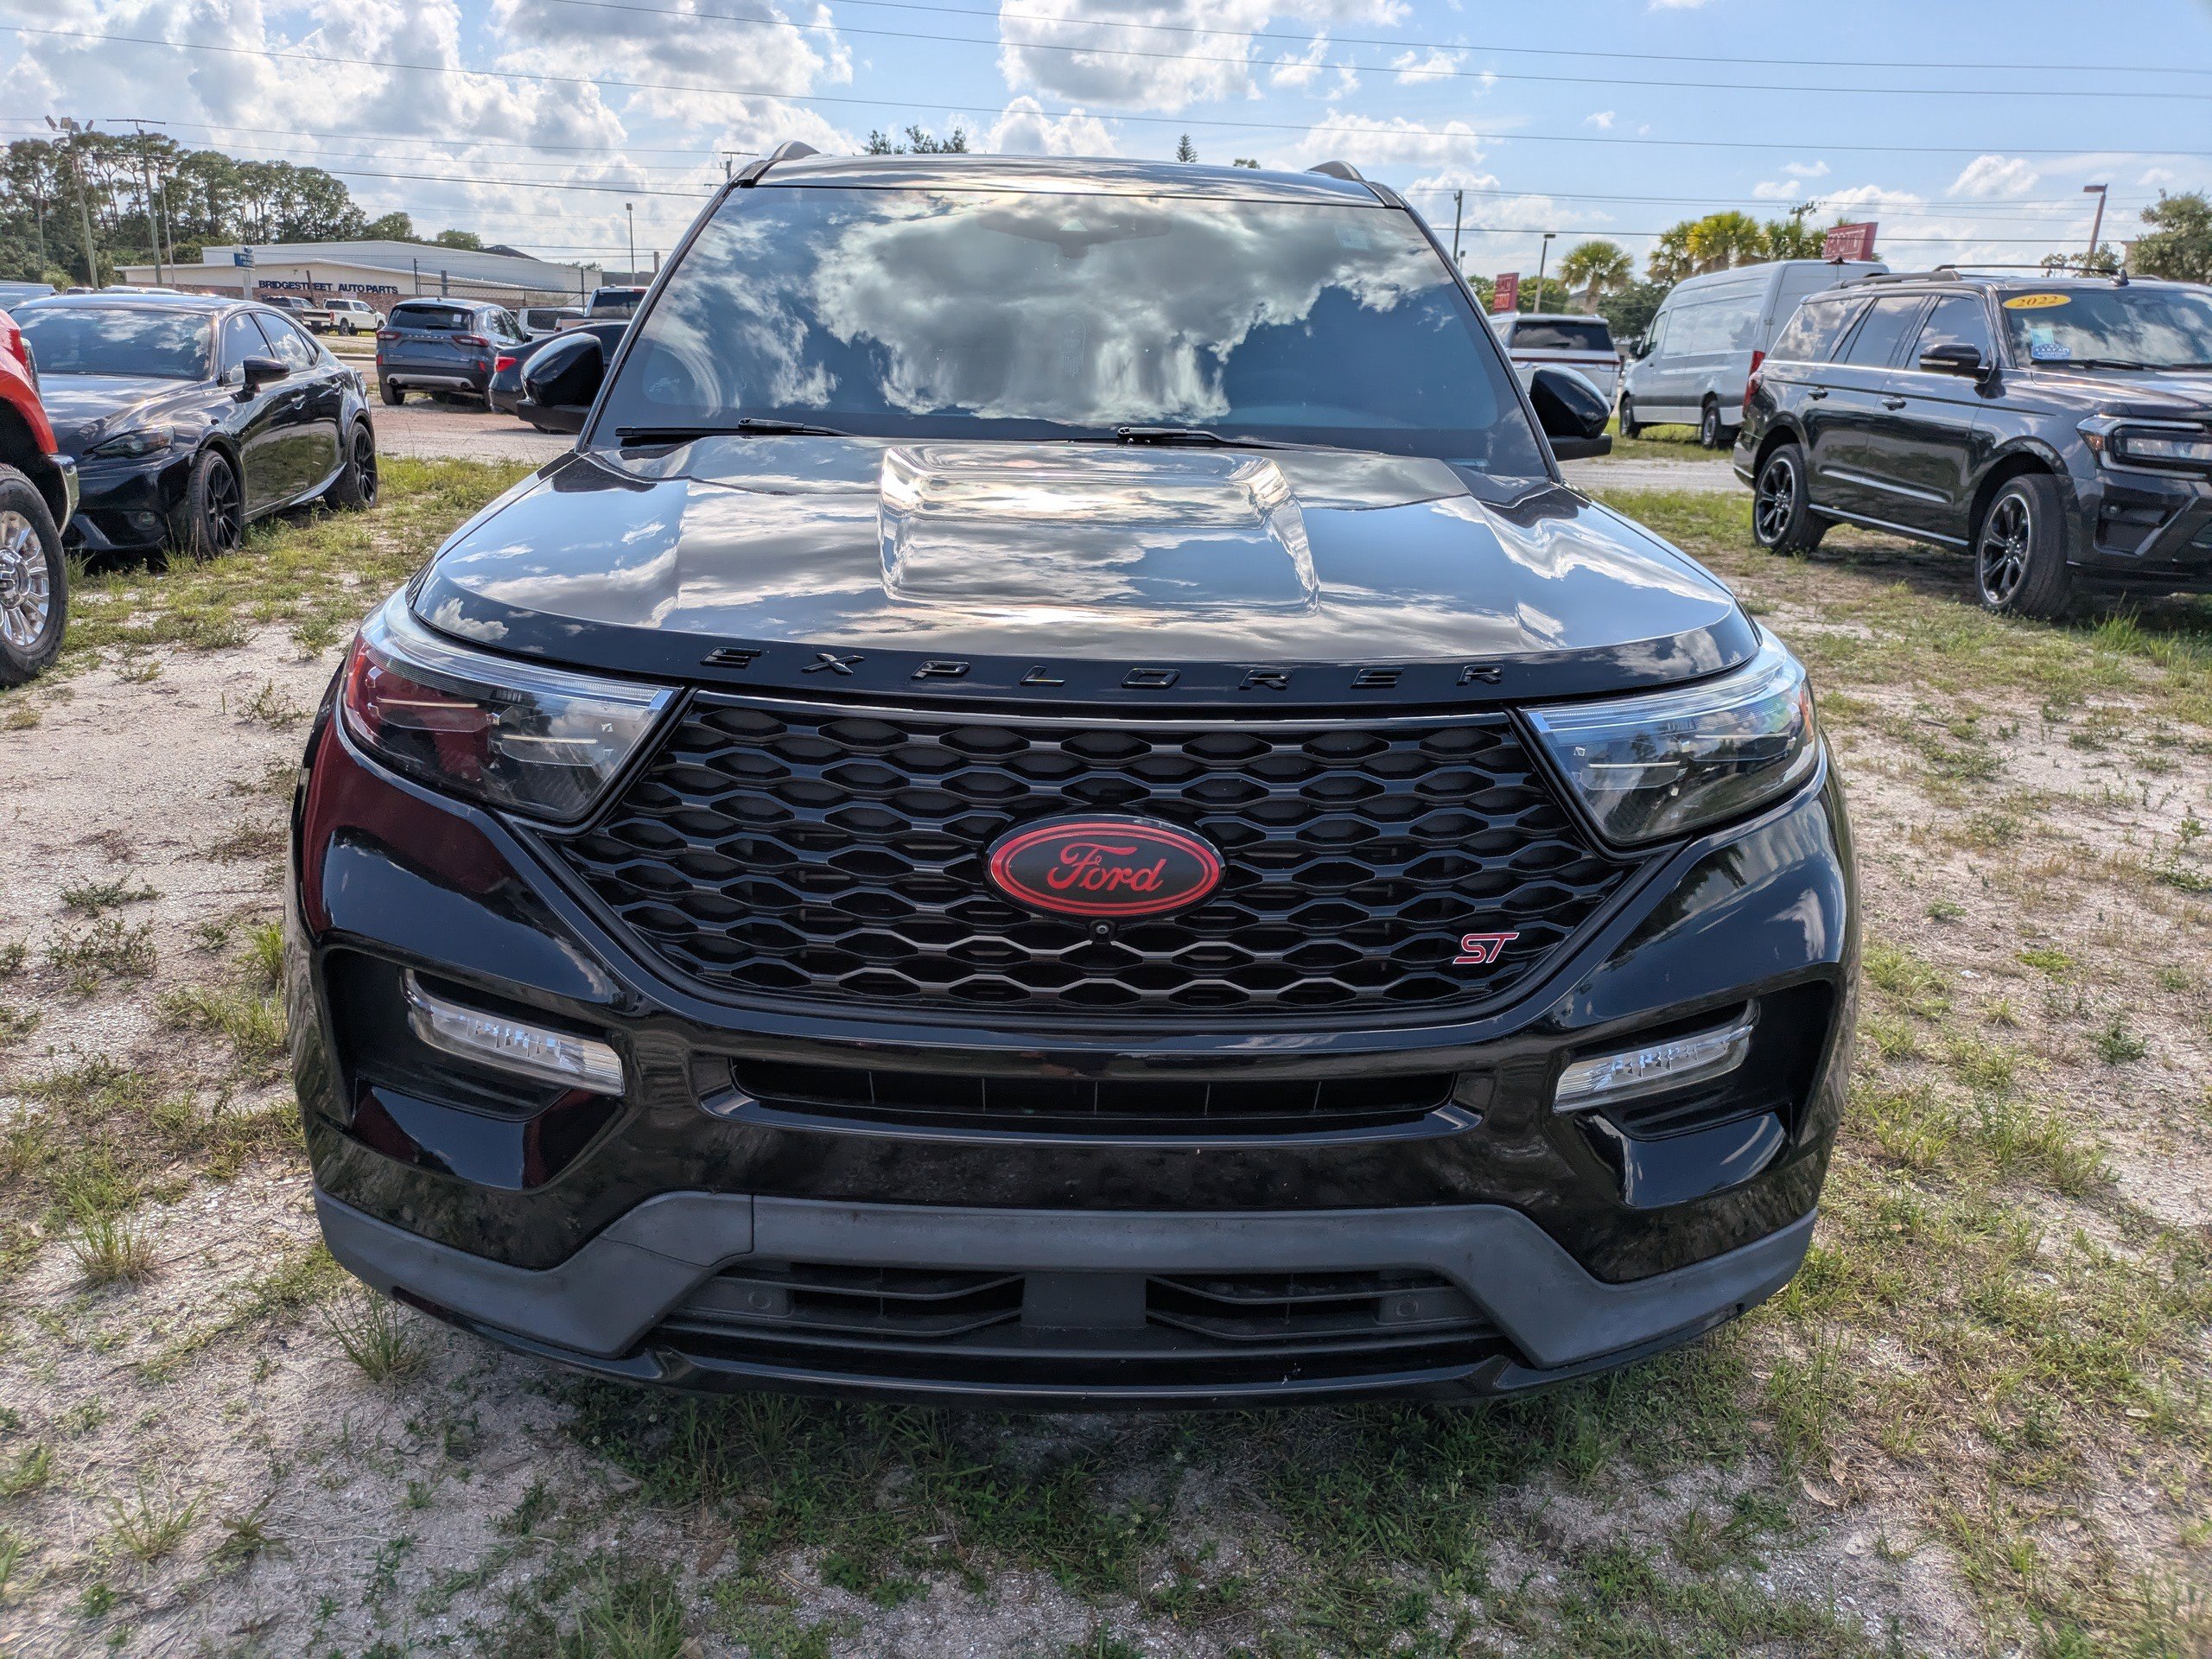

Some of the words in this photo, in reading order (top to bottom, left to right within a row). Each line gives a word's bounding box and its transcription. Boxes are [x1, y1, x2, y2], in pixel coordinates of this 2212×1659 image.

[338, 283, 365, 293] AUTO
[365, 284, 398, 295] PARTS
[2016, 296, 2058, 307] 2022
[700, 646, 1505, 689] EXPLORER
[1046, 842, 1167, 892] Ford
[1452, 932, 1520, 964] ST
